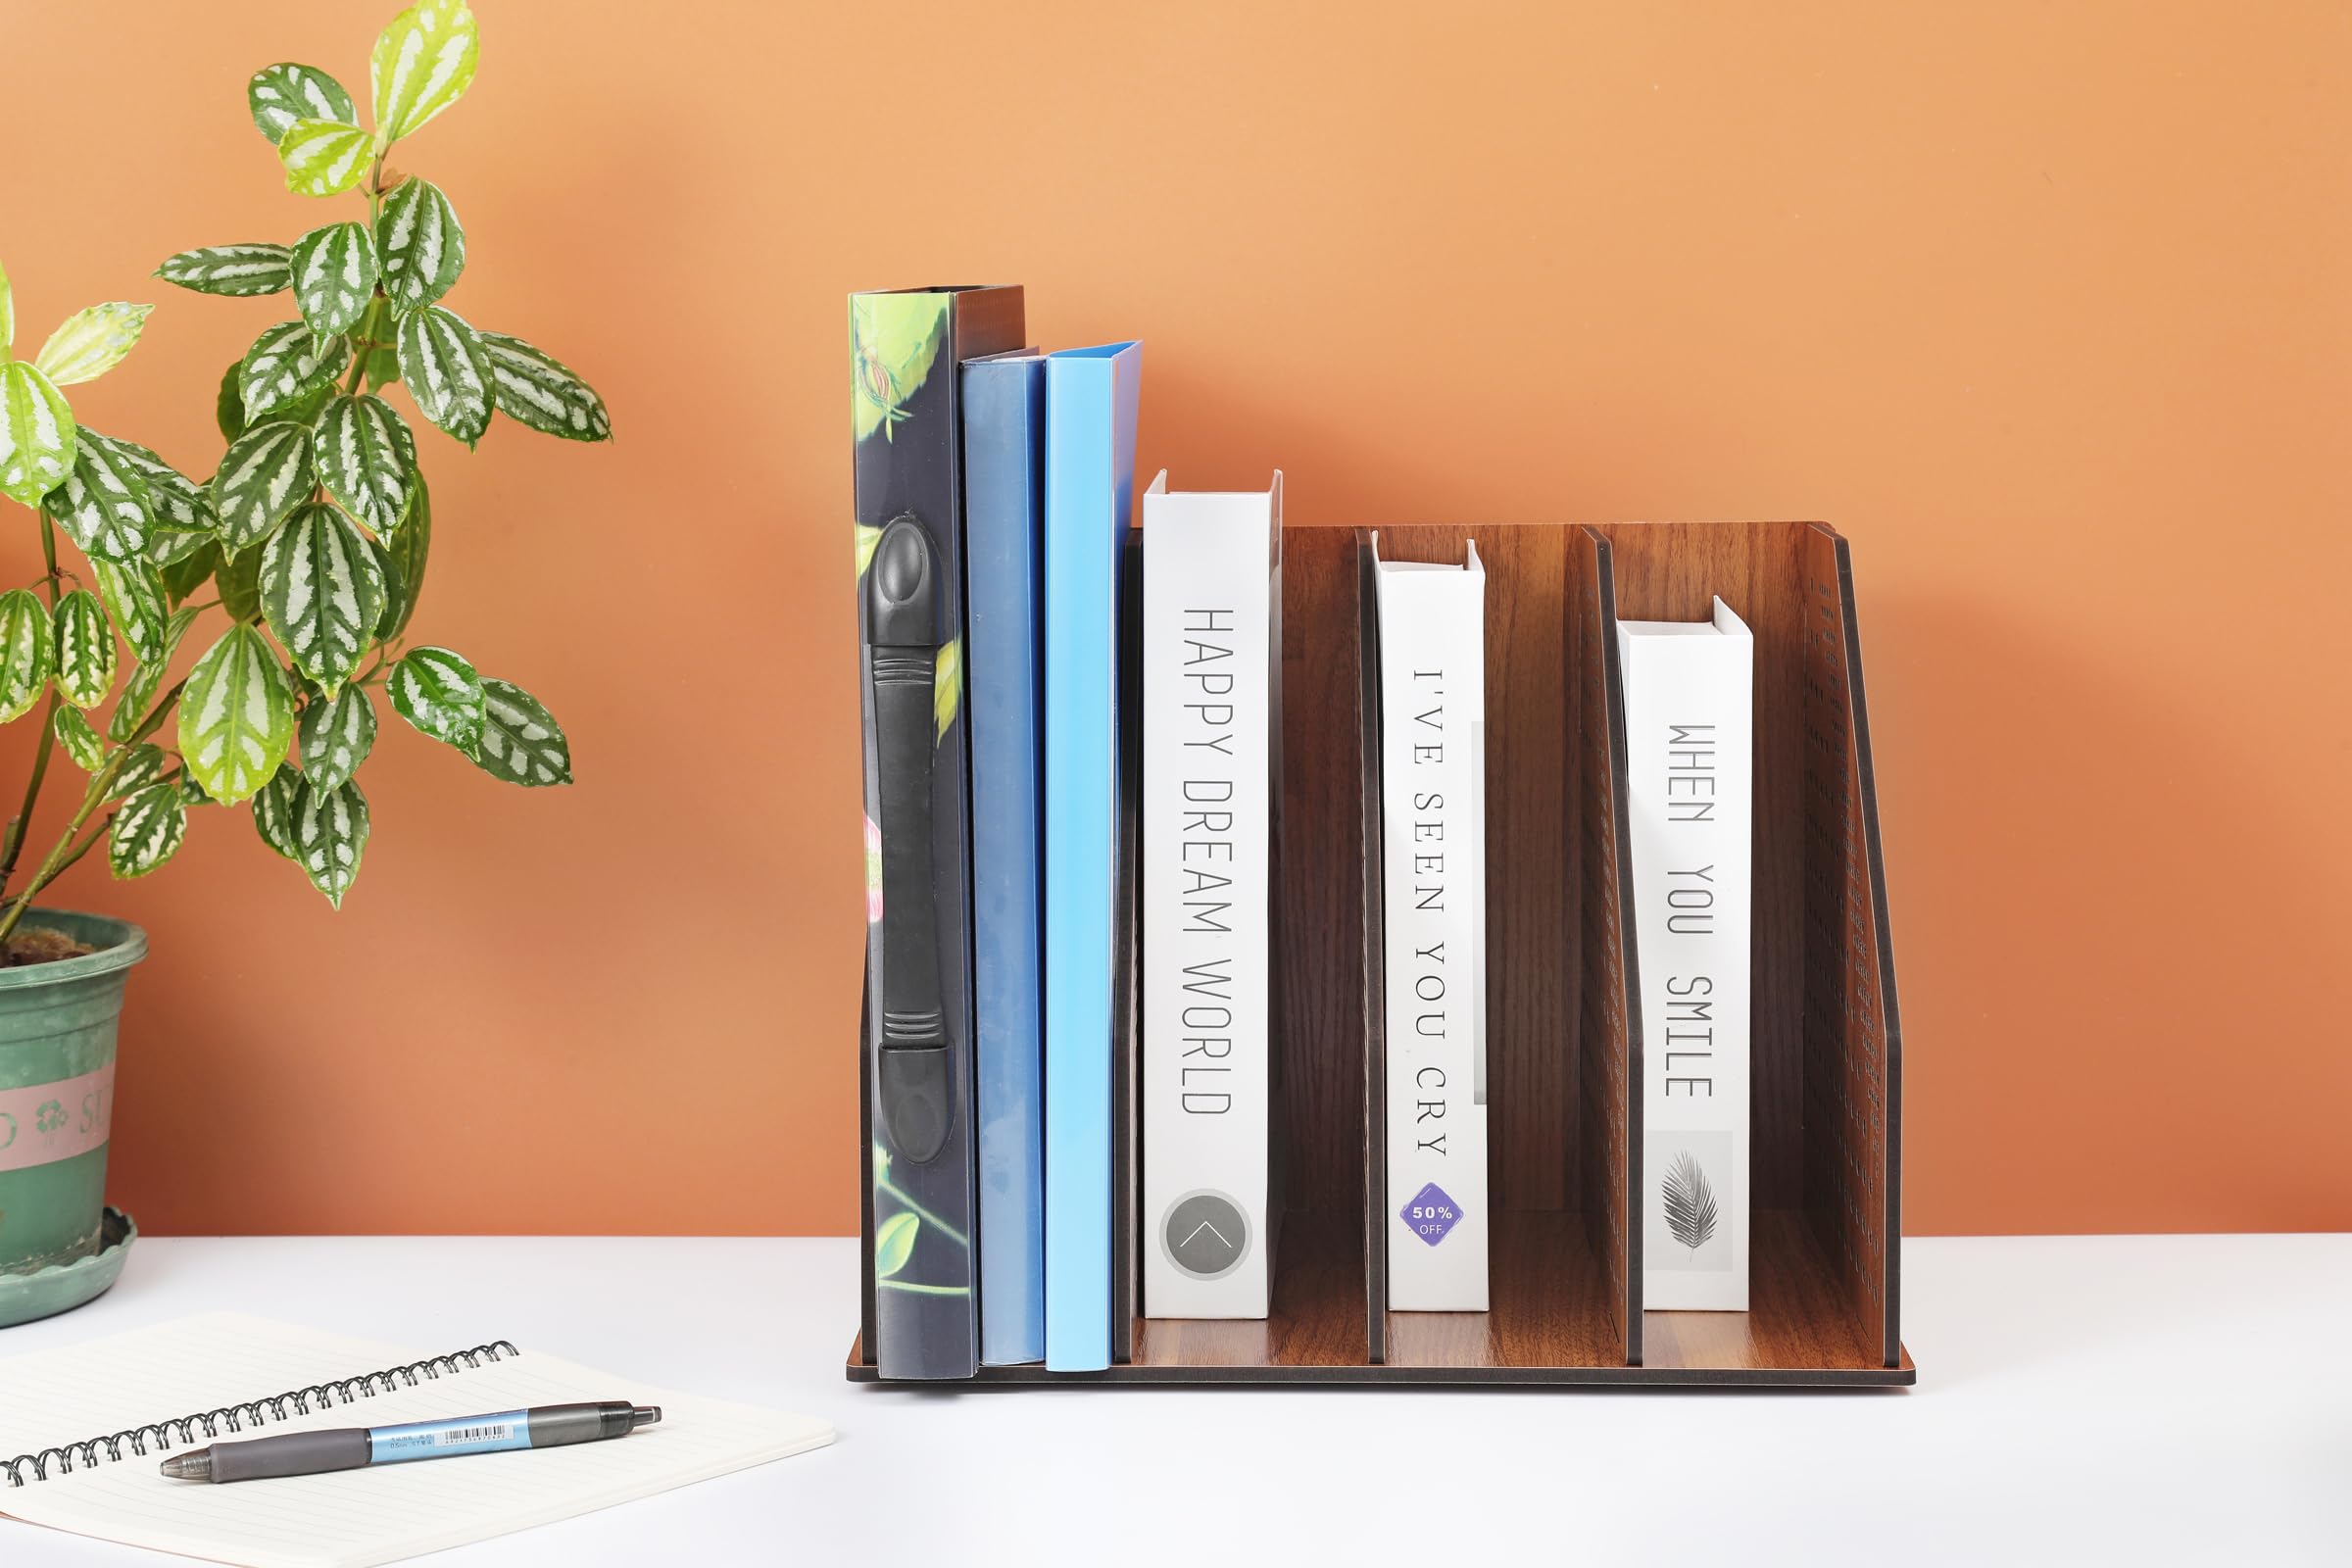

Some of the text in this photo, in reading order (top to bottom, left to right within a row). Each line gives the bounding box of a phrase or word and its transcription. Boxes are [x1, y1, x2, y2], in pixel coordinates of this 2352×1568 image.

[1181, 609, 1235, 1114] HAPPY DREAM WORLD
[1413, 668, 1446, 1157] I'VE SEEN YOU CRY
[1665, 724, 1716, 1098] WHEN YOU SMILE
[1412, 1206, 1452, 1219] 50%
[1419, 1224, 1443, 1235] OFF
